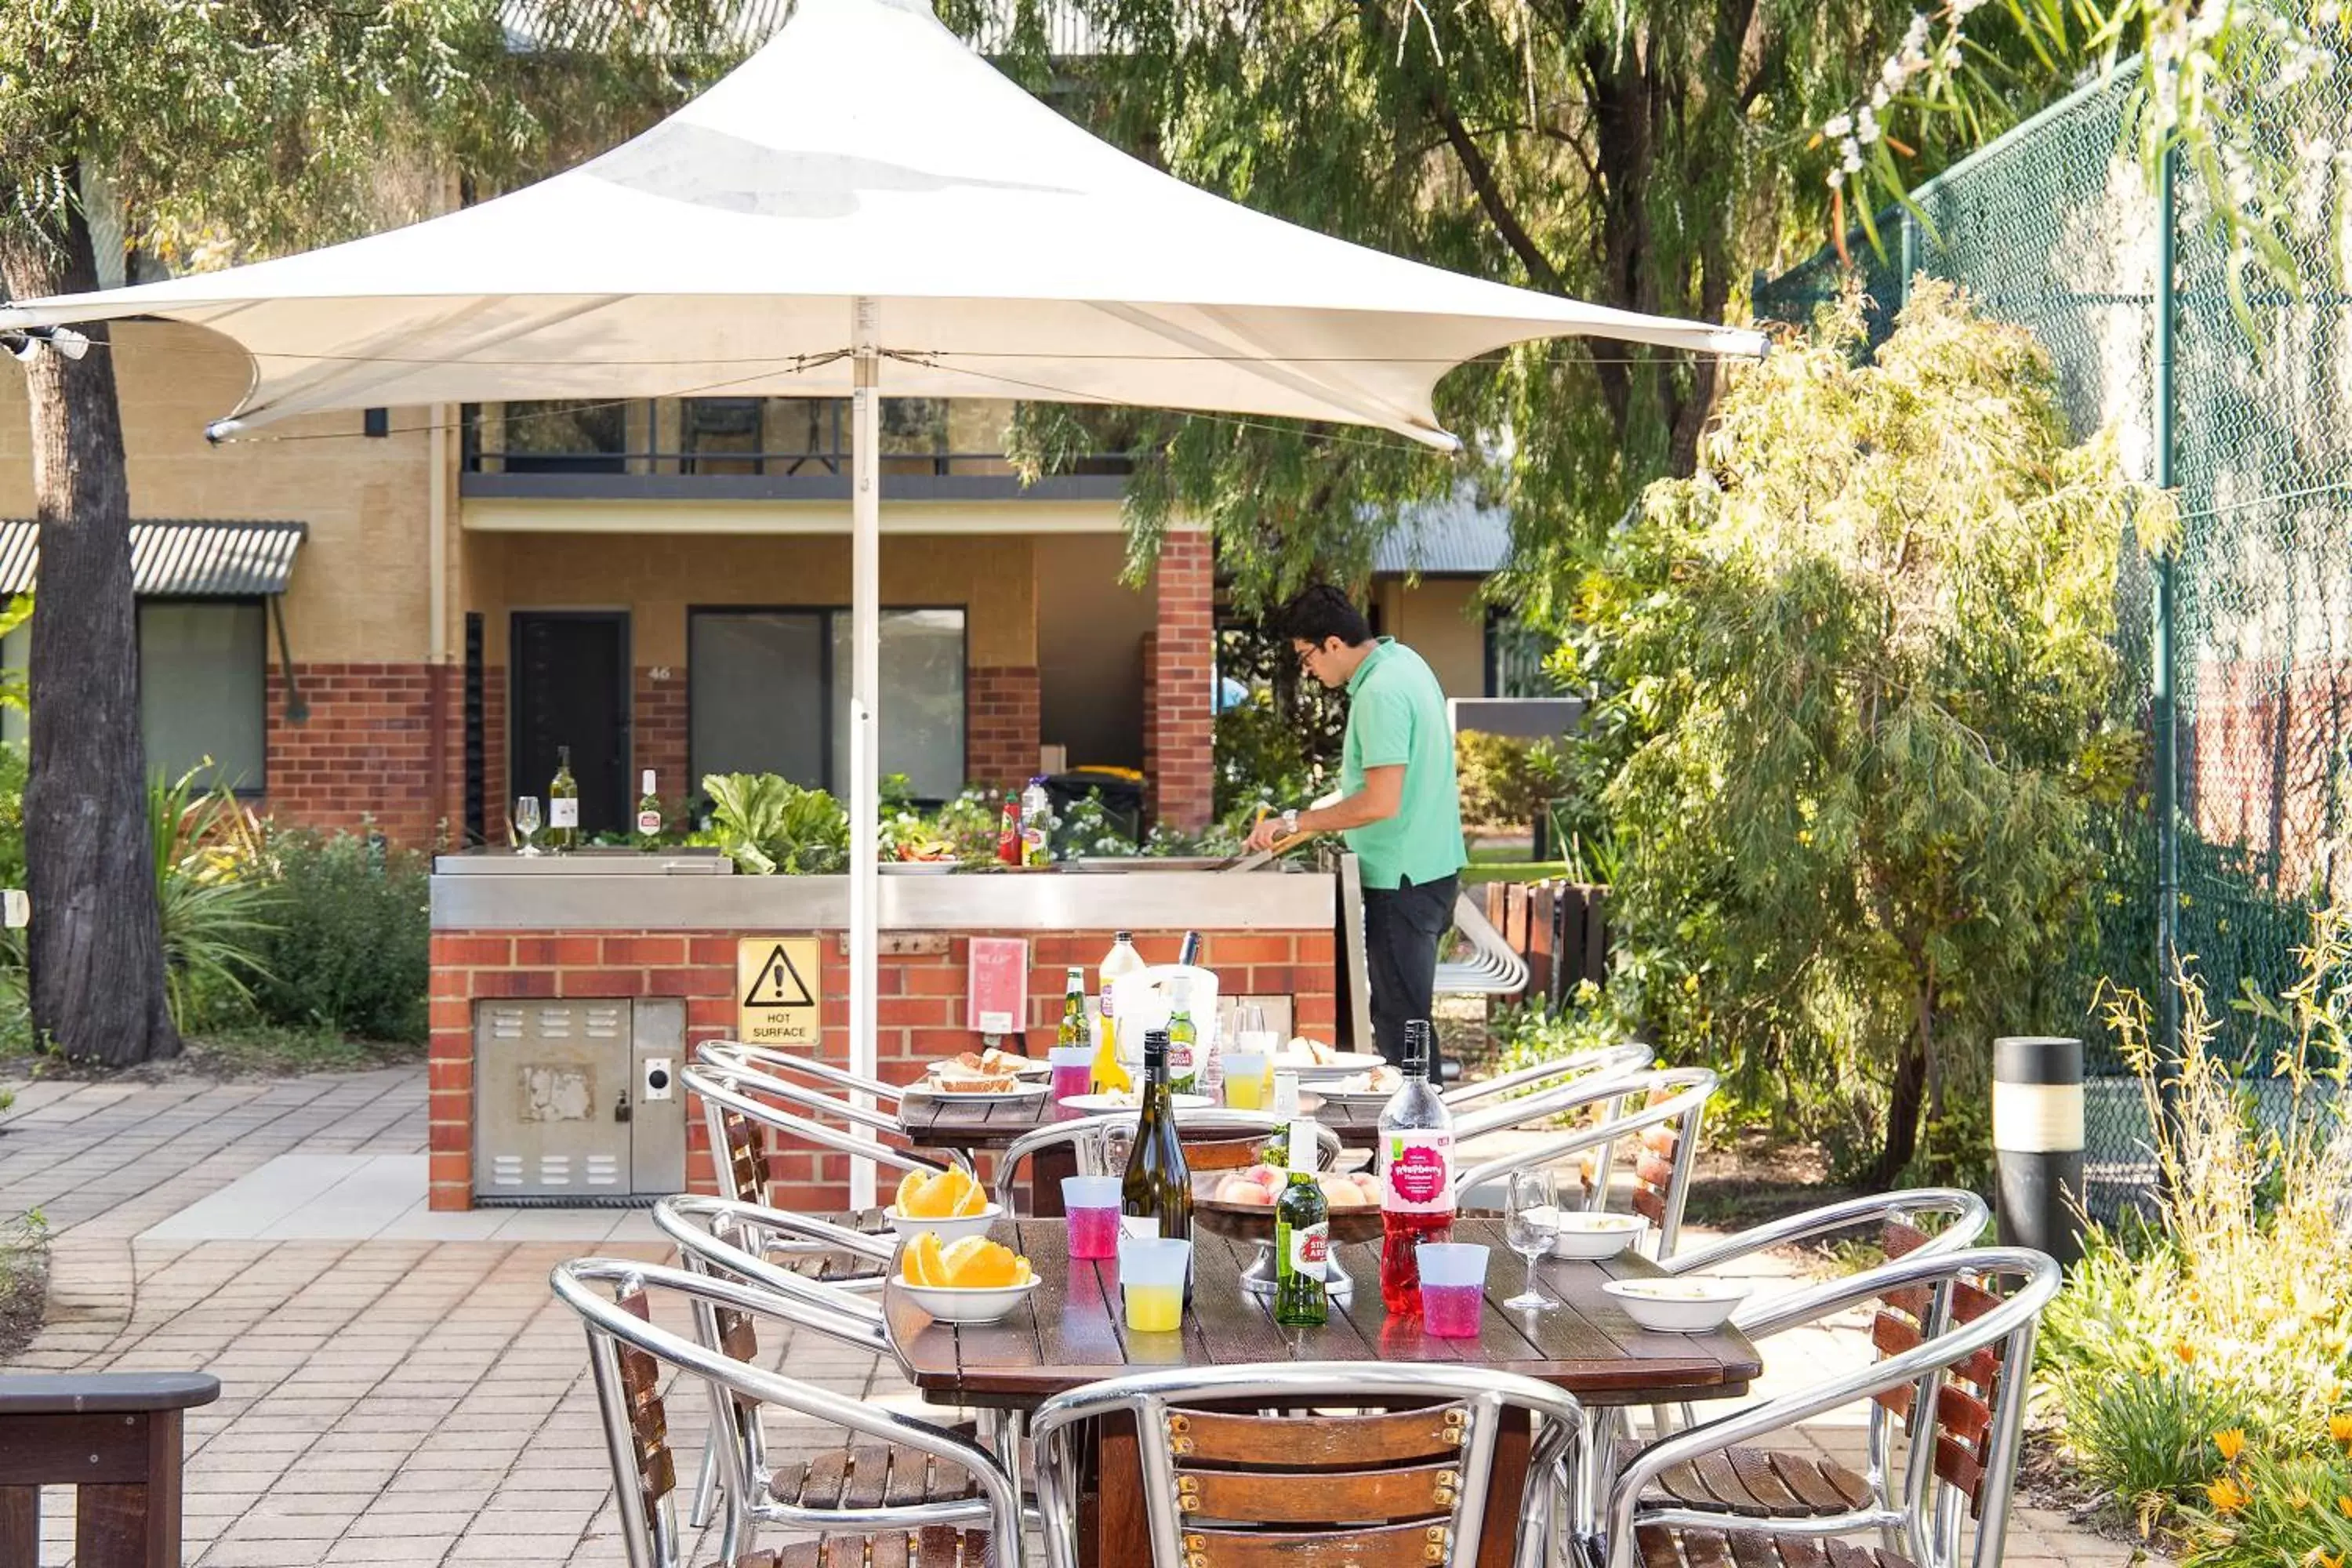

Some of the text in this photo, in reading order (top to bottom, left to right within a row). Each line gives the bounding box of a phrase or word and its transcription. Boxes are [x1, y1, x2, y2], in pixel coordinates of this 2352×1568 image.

[648, 666, 671, 681] 46
[768, 1014, 791, 1023] HOT
[753, 1028, 807, 1037] SURFACE
